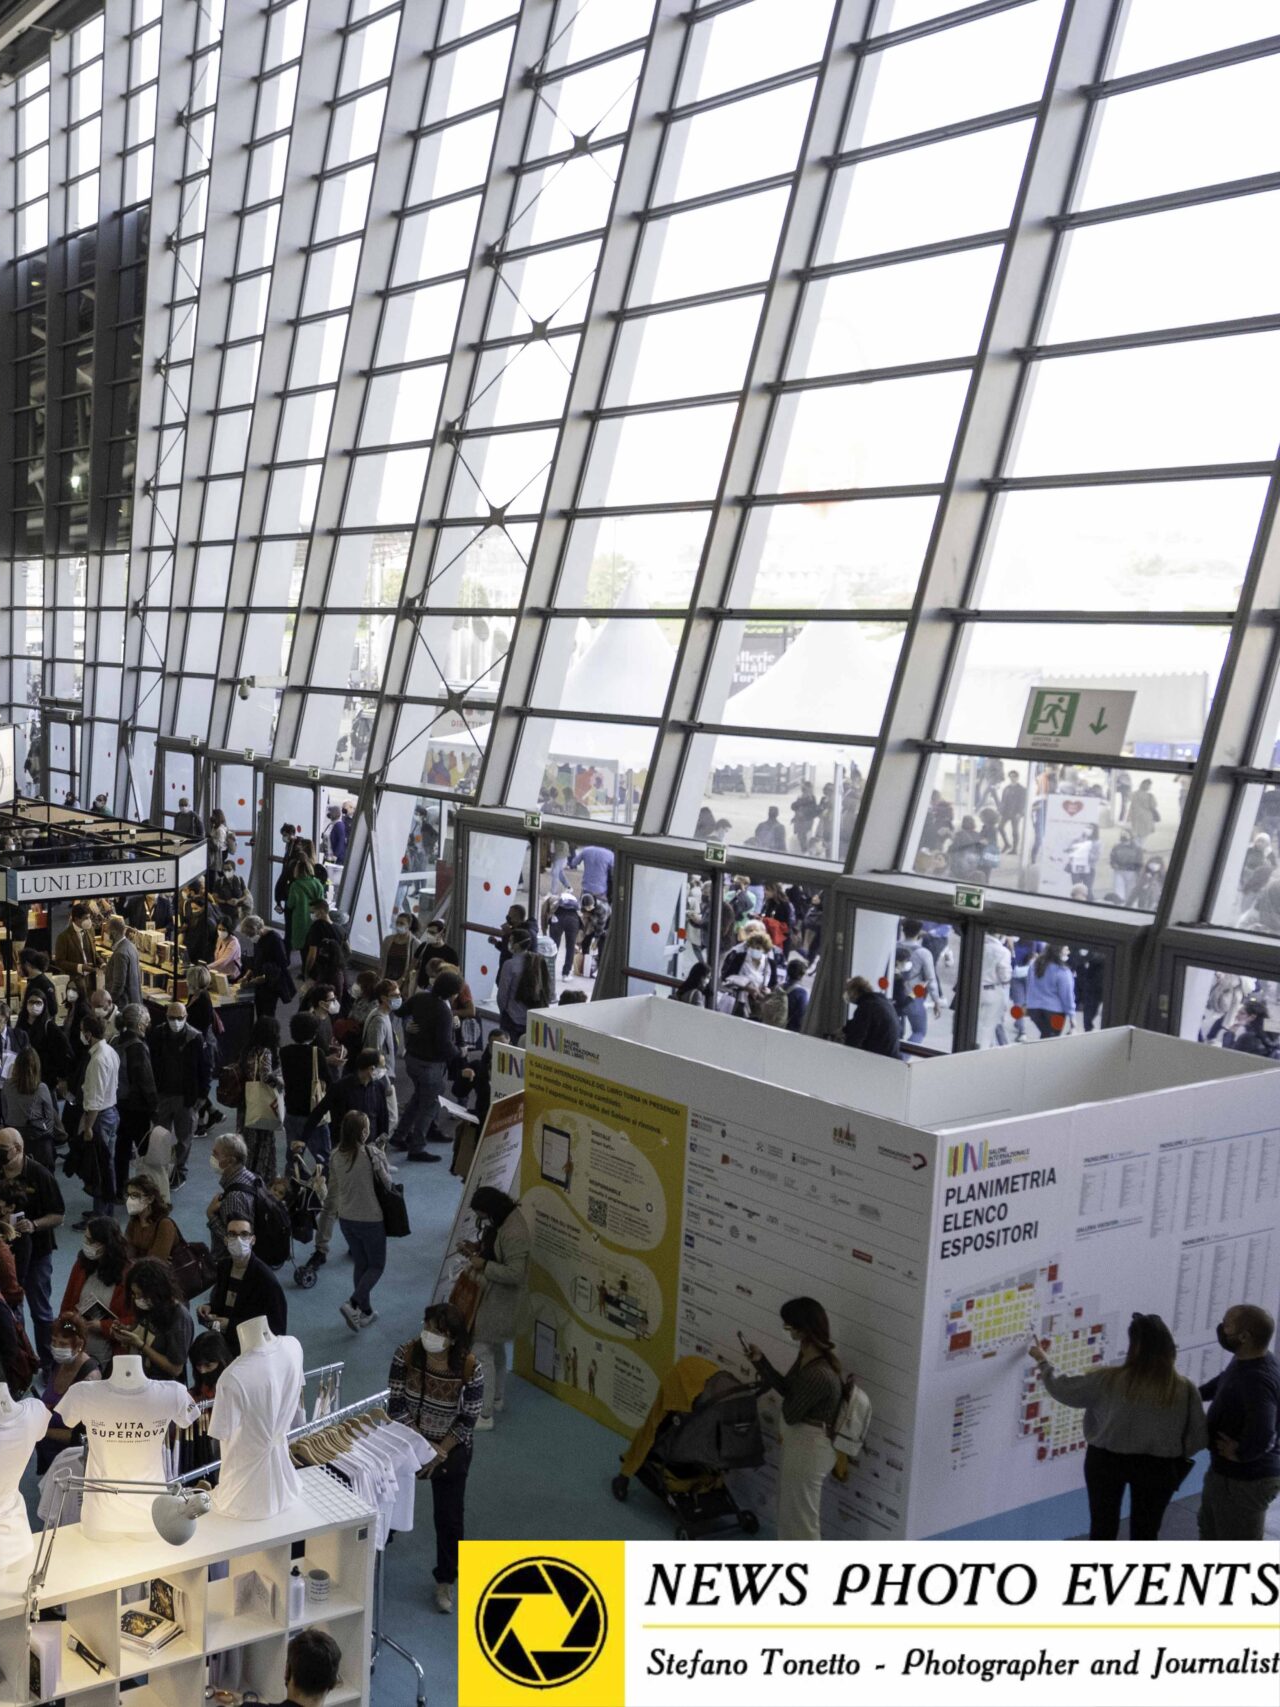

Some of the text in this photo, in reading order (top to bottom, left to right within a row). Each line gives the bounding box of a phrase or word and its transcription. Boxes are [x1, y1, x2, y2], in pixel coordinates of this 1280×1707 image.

[20, 867, 167, 894] LUNI EDITRICE
[944, 1167, 1057, 1207] PLANIMETRIA
[942, 1202, 1008, 1234] ELENCO
[940, 1220, 1039, 1260] ESPOSITORI
[91, 1427, 165, 1439] SUPERNOVA
[115, 1422, 144, 1430] VITA
